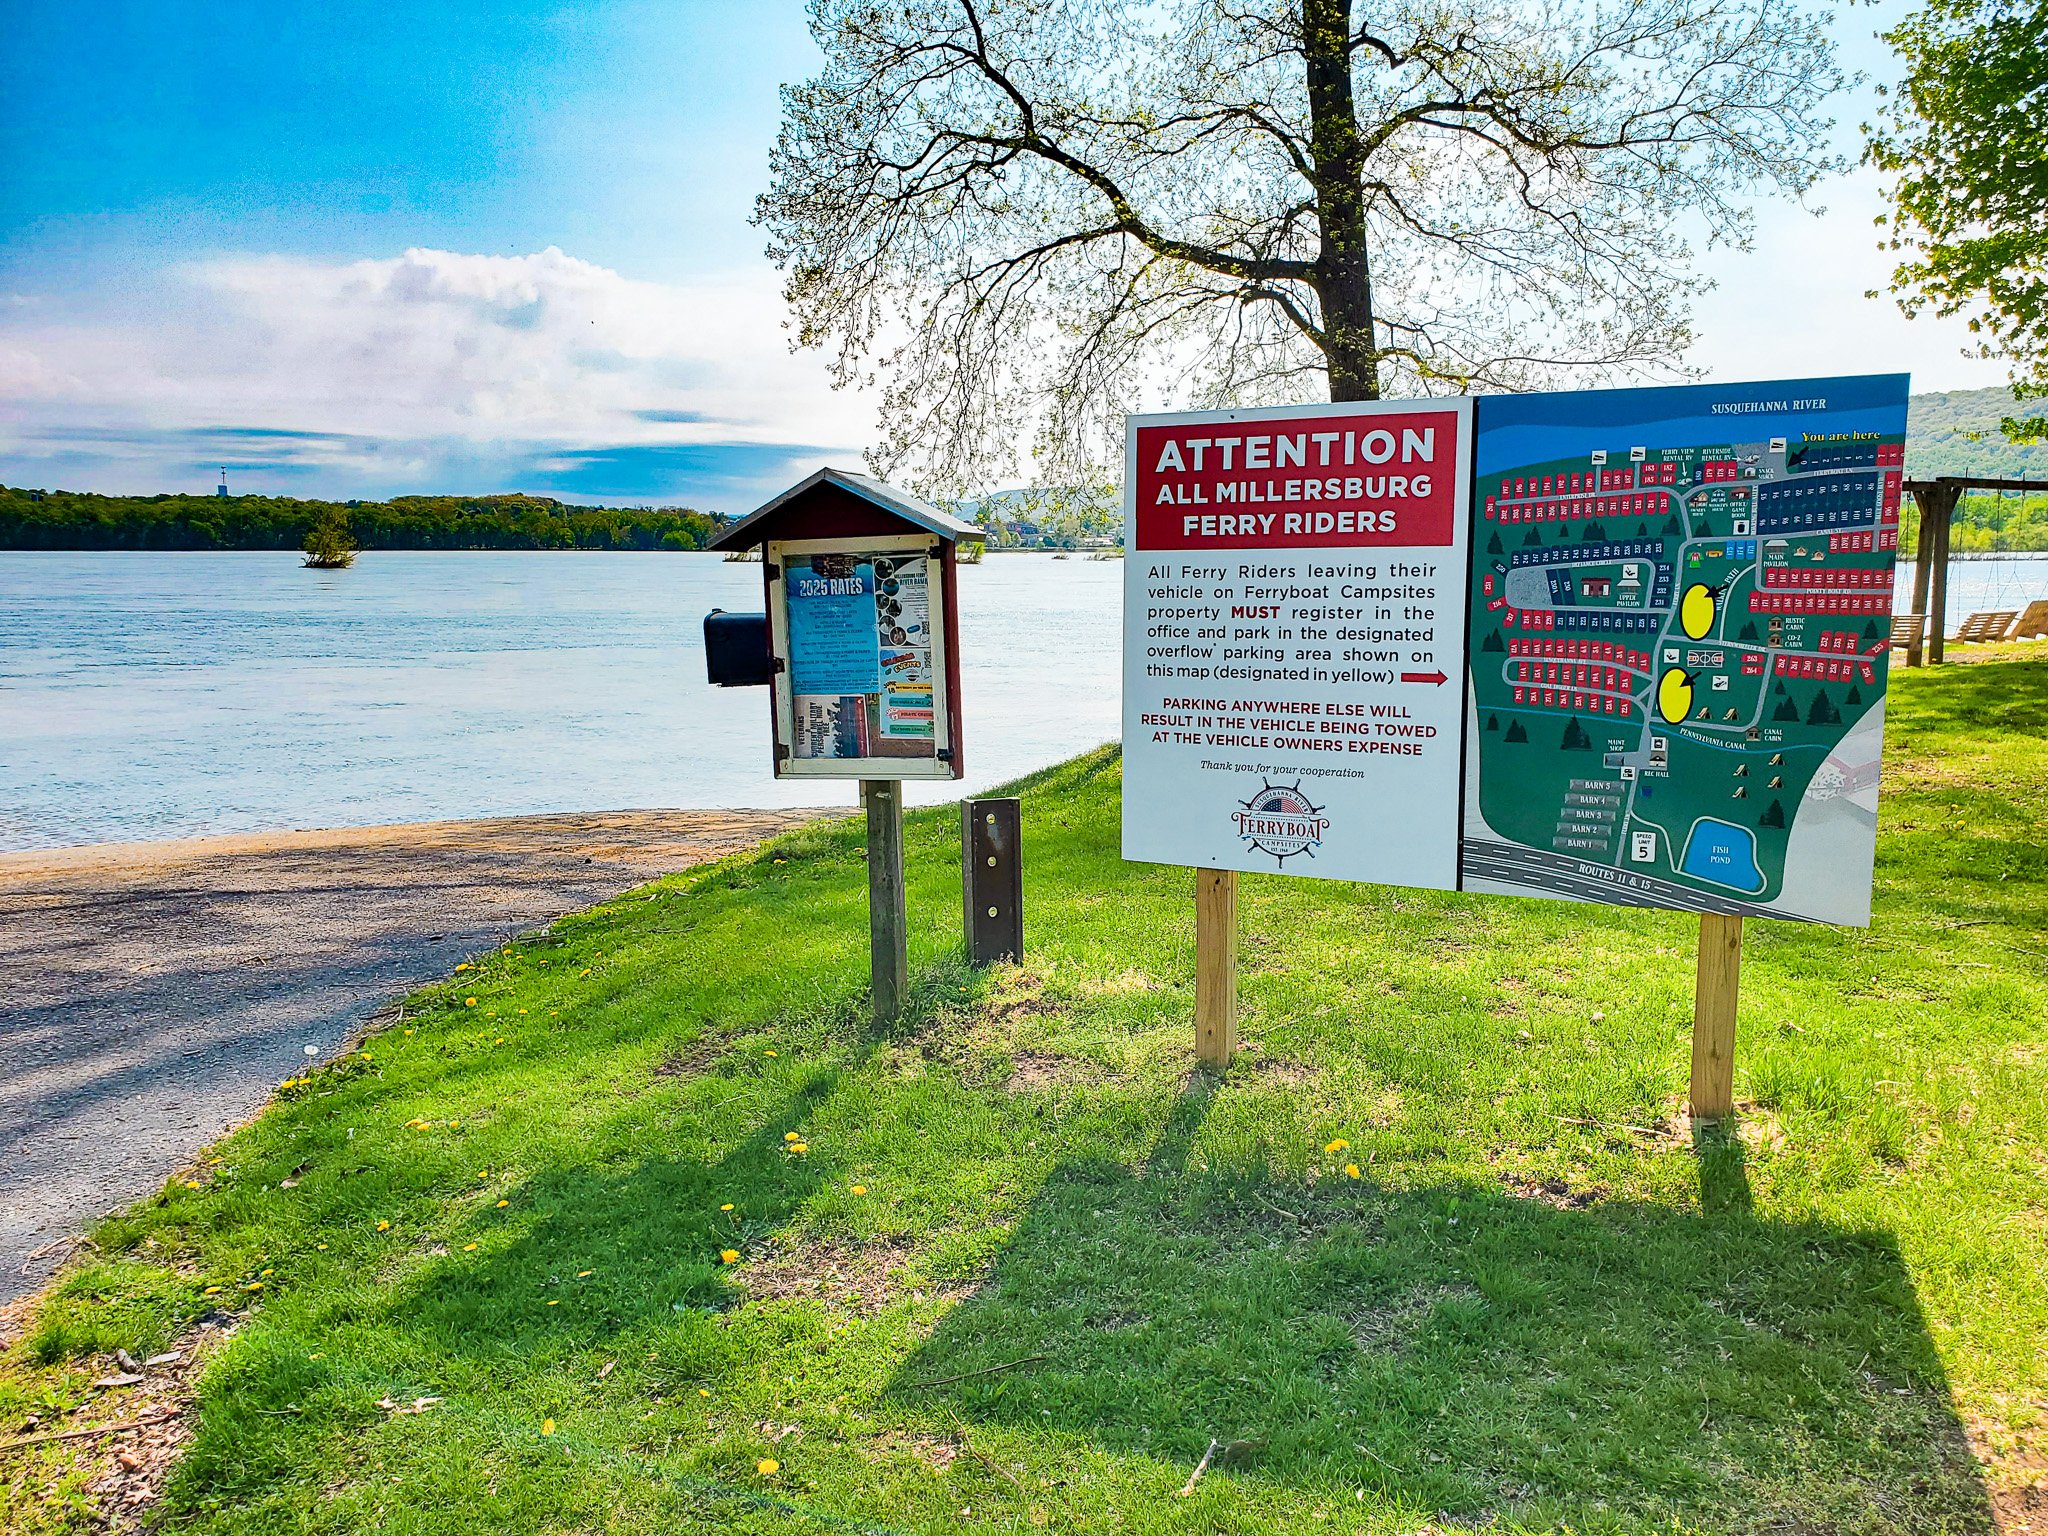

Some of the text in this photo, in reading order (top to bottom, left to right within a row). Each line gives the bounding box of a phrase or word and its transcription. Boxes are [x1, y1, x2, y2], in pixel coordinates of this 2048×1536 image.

[1712, 399, 1826, 414] SUSQUEHANNA RIVER
[1802, 432, 1824, 442] You
[1853, 431, 1880, 440] here
[1155, 428, 1434, 473] ATTENTION
[1156, 475, 1432, 505] ALL MILLERSBURG
[1183, 511, 1396, 536] FERRY RIDERS
[1149, 563, 1437, 582] All Ferry Riders leaving their
[800, 578, 862, 596] 2025 RATES
[1149, 585, 1435, 601] vehicle on Ferryboat Campsites
[1148, 606, 1434, 622] property MUST register in the
[1147, 626, 1434, 644] office and park in the designated
[1147, 645, 1433, 663] overflow parking area shown on
[1147, 664, 1394, 685] this map (designated in yellow)
[1163, 698, 1411, 718] PARKING ANYWHERE ELSE WILL
[1142, 714, 1436, 738] RESULT IN THE VEHICLE BEING TOWED
[1152, 732, 1422, 755] AT THE VEHICLE OWNERS EXPENSE
[1680, 727, 1747, 750] PENNSYLVANIA CANAL
[1201, 760, 1365, 778] Thank you for your cooperation
[1255, 790, 1308, 812] SUSQUEHANNA RIVER
[1231, 812, 1330, 842] FERRYBOAT
[1639, 846, 1648, 858] 5
[1712, 846, 1728, 854] FISH
[1710, 856, 1730, 864] POND
[1579, 863, 1652, 889] ROUTES 11 & 15
